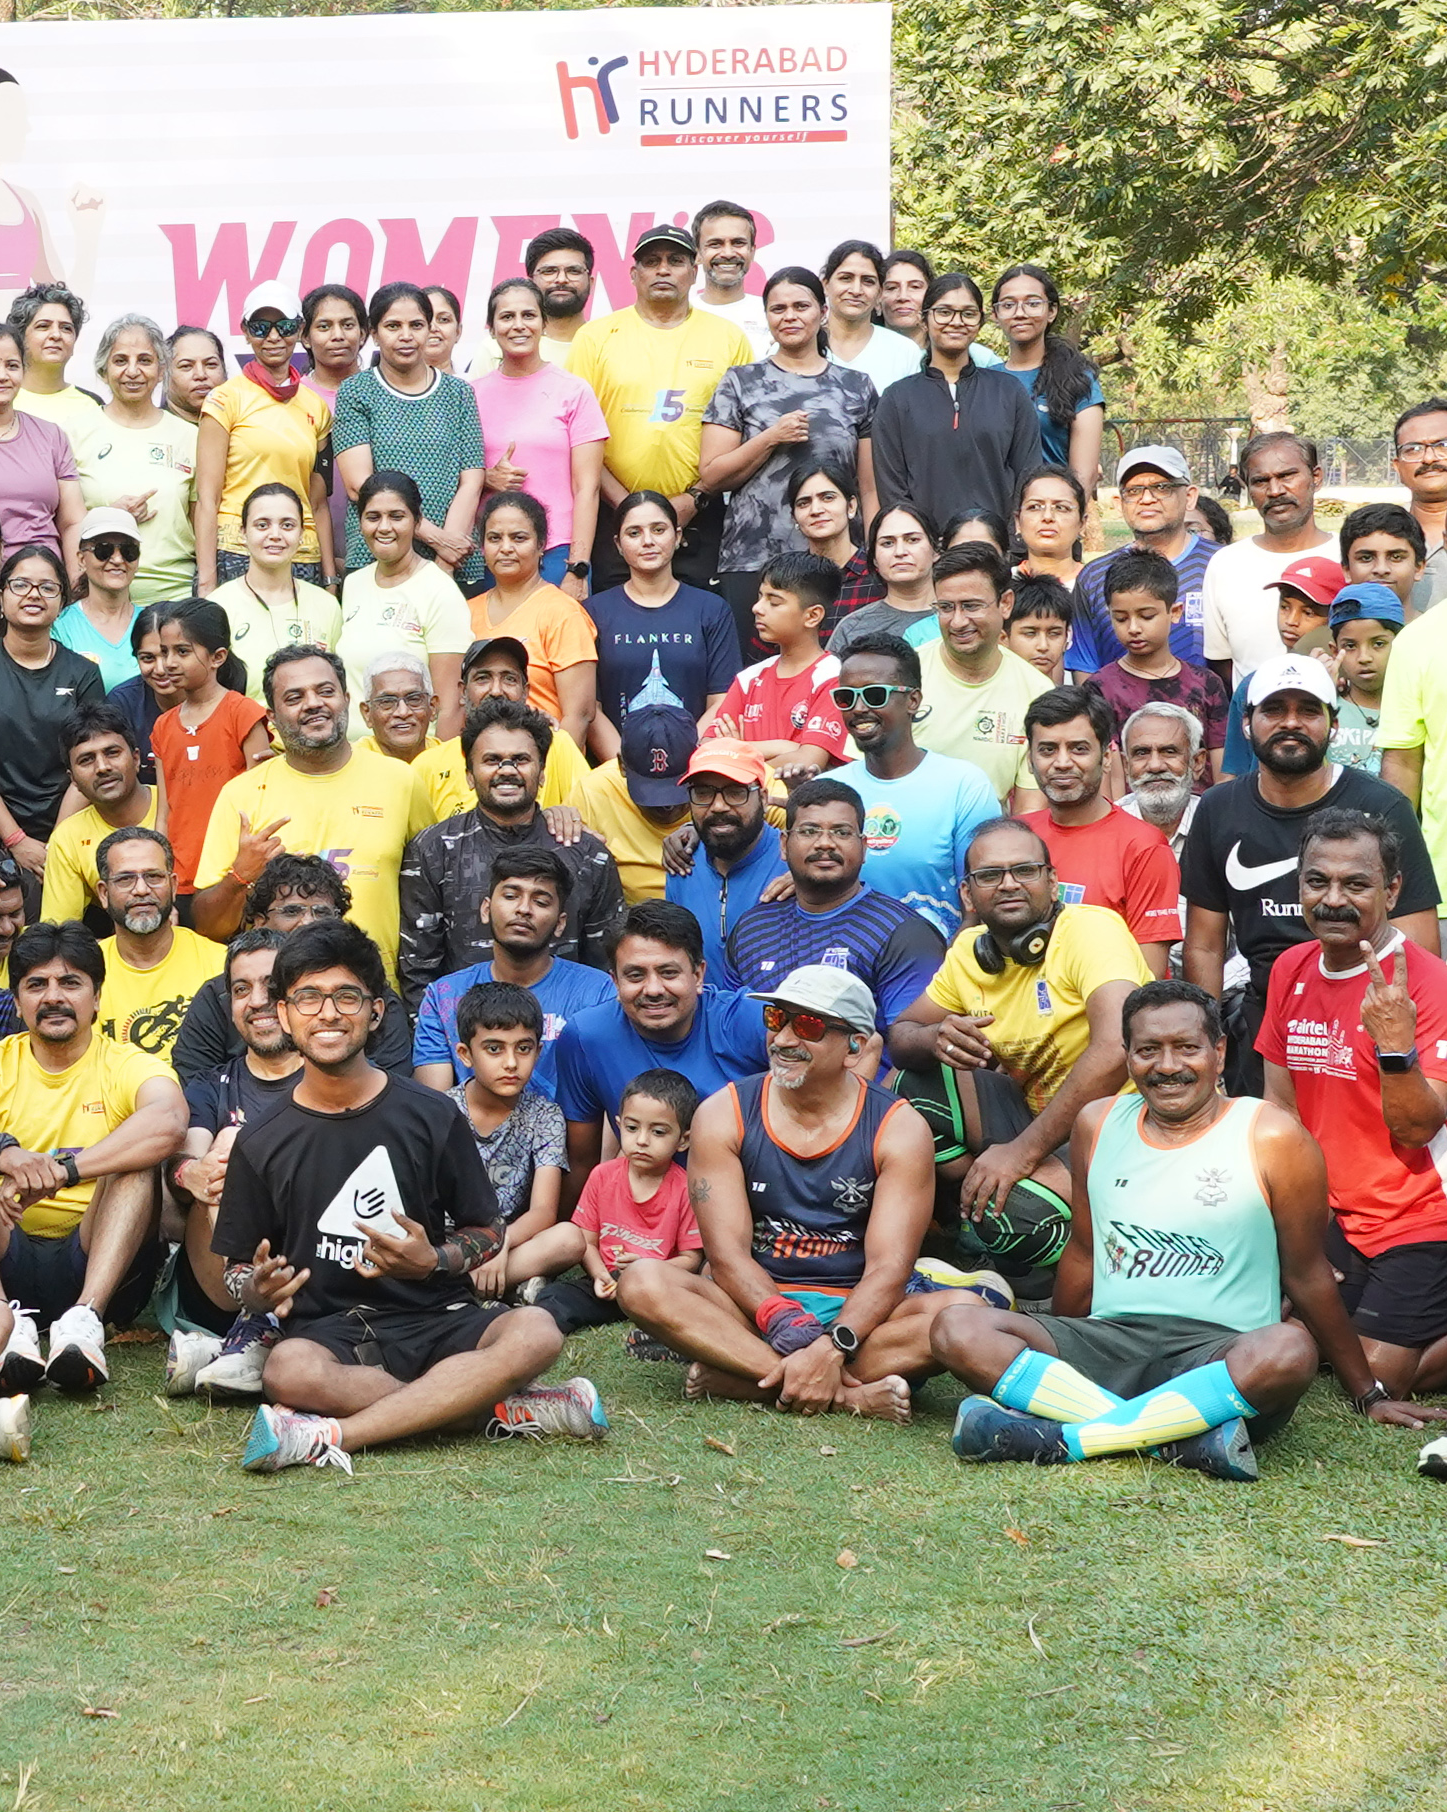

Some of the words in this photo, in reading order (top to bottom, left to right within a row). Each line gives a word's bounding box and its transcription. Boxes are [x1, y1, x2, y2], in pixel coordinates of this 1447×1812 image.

[638, 45, 848, 78] HYDERABAD
[639, 93, 848, 127] RUNNERS
[675, 130, 741, 144] discover
[745, 129, 808, 143] yourself
[614, 634, 693, 645] FLANKER
[1297, 1019, 1329, 1037] airtel
[1109, 1220, 1225, 1258] FORCES
[1126, 1248, 1225, 1279] RUNNER
